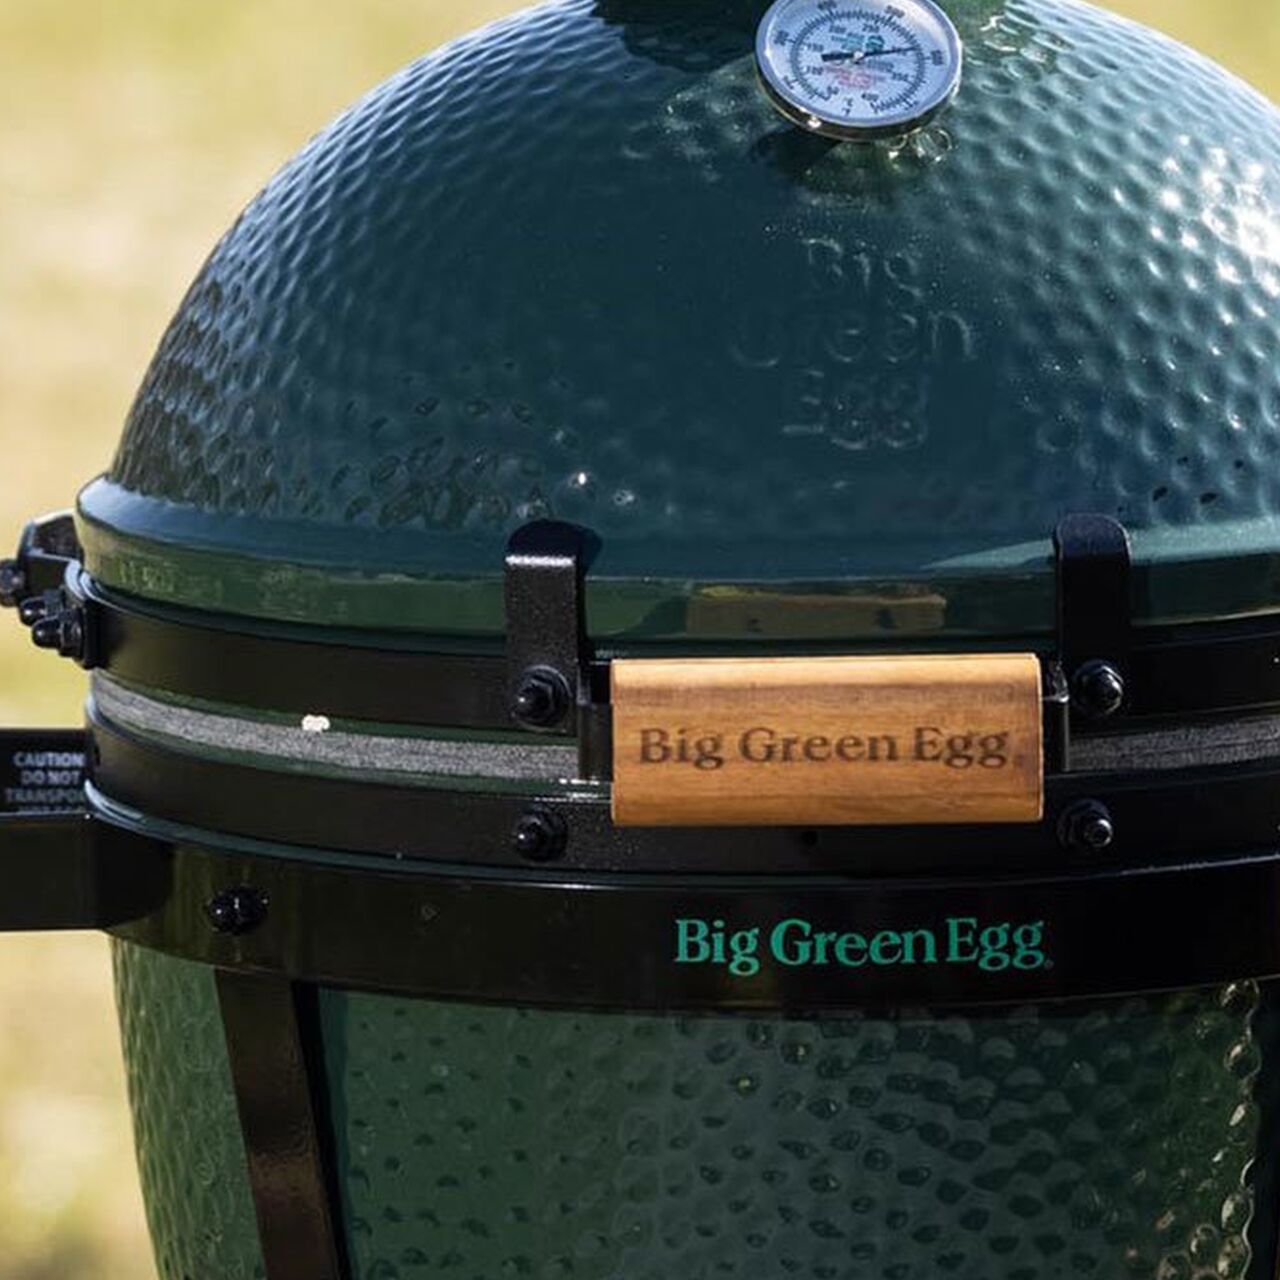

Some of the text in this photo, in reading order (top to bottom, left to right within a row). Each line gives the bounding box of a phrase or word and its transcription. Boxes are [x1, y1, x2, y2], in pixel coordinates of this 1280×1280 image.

[639, 726, 1010, 771] Big Green Egg
[13, 751, 86, 767] CAUTION
[21, 770, 81, 785] DO NOT
[5, 787, 85, 803] TRANSPO
[674, 918, 1046, 976] Big Green Egg
